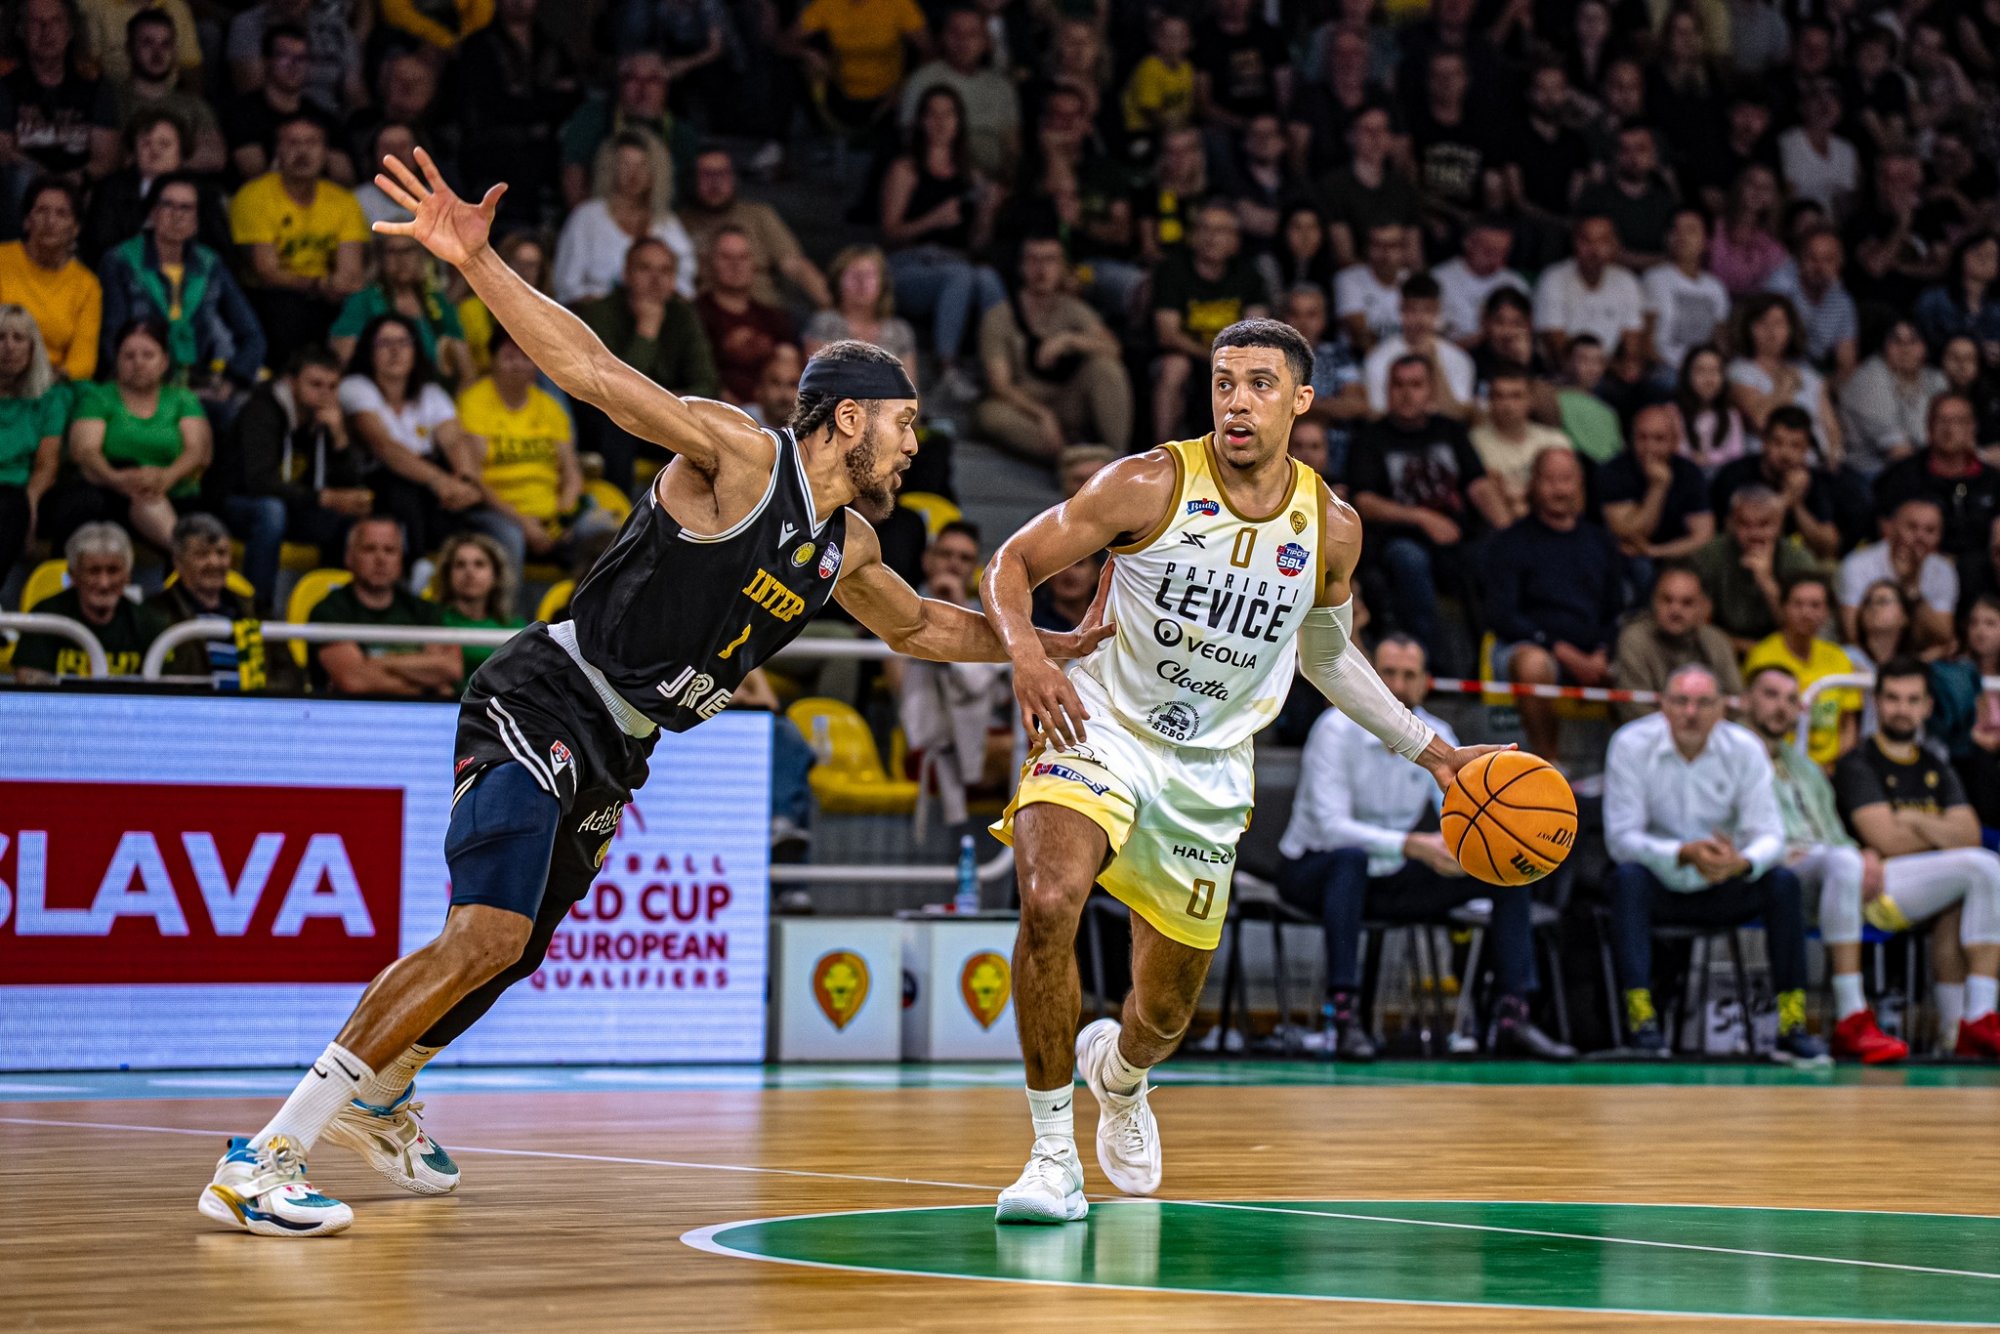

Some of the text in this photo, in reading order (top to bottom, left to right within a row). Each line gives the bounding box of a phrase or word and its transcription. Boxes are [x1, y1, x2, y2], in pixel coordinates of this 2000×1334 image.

[820, 554, 834, 574] SBL
[1230, 527, 1258, 569] 0
[1278, 555, 1303, 571] SBL
[1286, 548, 1308, 559] TIPOS
[742, 568, 805, 622] INTER
[1165, 562, 1299, 604] PATRIOTI
[1155, 577, 1292, 643] LEVICE
[1187, 636, 1257, 669] VEOLIA
[1156, 659, 1229, 701] Cloetta
[1151, 720, 1185, 741] ŠEBO
[0, 830, 376, 937] LAVA
[639, 882, 732, 922] CUP
[1186, 878, 1216, 920] 0
[547, 932, 728, 961] EUROPEAN
[530, 969, 728, 990] QUALIFIERS
